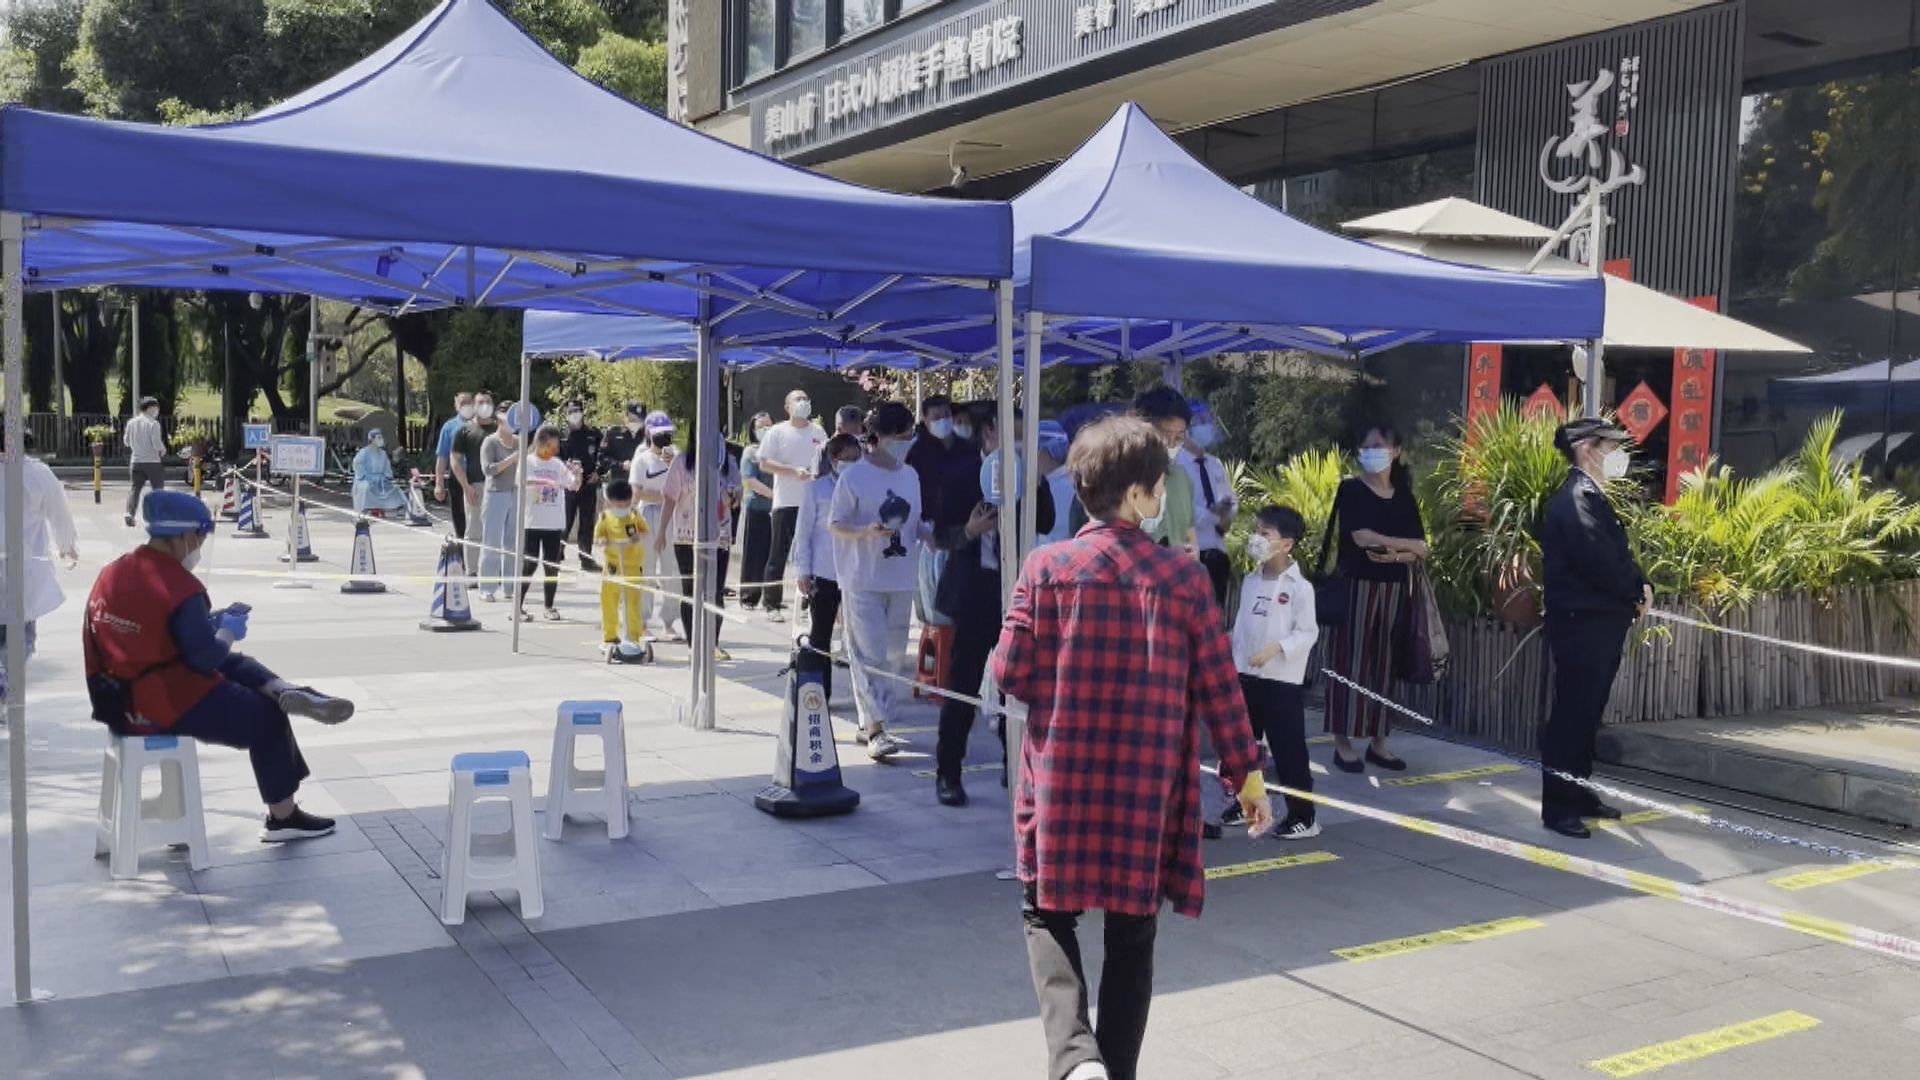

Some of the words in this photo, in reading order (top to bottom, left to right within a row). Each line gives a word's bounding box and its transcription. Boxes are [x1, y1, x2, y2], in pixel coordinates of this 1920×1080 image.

[248, 430, 268, 442] 入口
[808, 713, 822, 763] 招商积余
